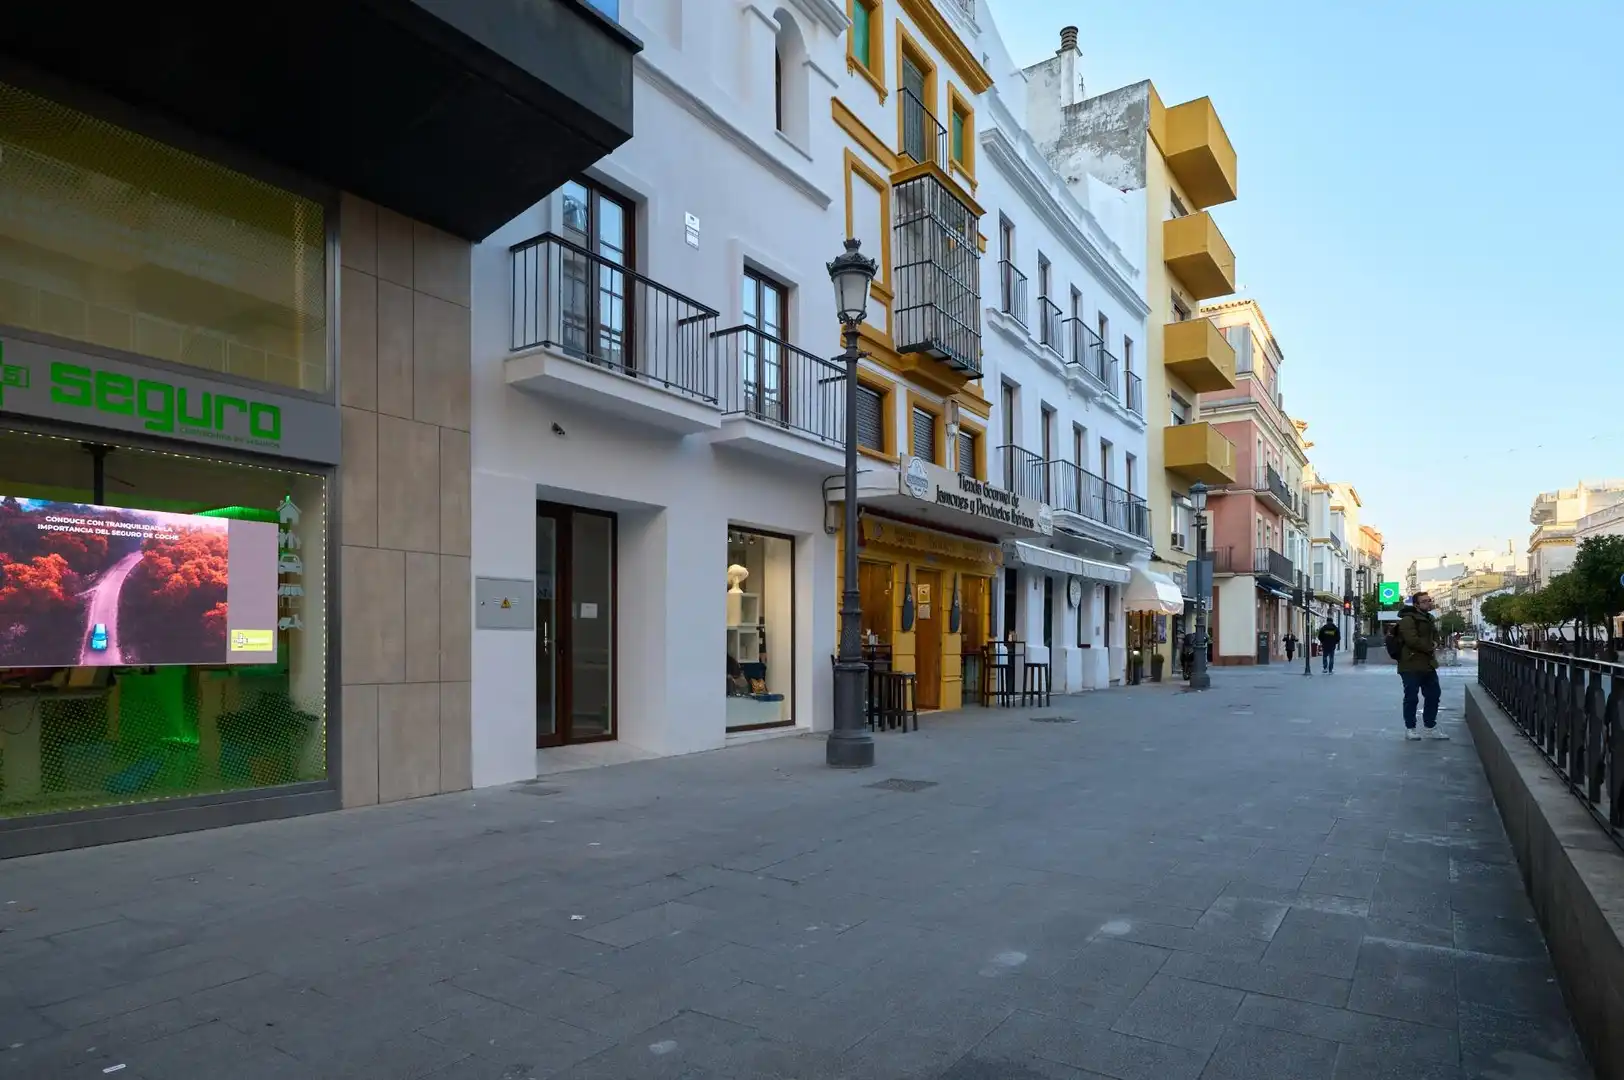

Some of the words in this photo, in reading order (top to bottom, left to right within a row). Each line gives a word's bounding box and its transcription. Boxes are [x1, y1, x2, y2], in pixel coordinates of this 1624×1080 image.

[50, 361, 281, 441] seguro
[936, 484, 969, 510] Jamones
[970, 499, 975, 515] y
[976, 498, 1010, 522] Productos
[958, 472, 982, 495] Tienda
[1011, 495, 1020, 509] de
[37, 523, 93, 534] IMPORTANCIA
[111, 529, 142, 538] SEGURO
[154, 533, 179, 541] COCHE
[45, 515, 86, 525] CONDUCE
[87, 519, 104, 527] CON
